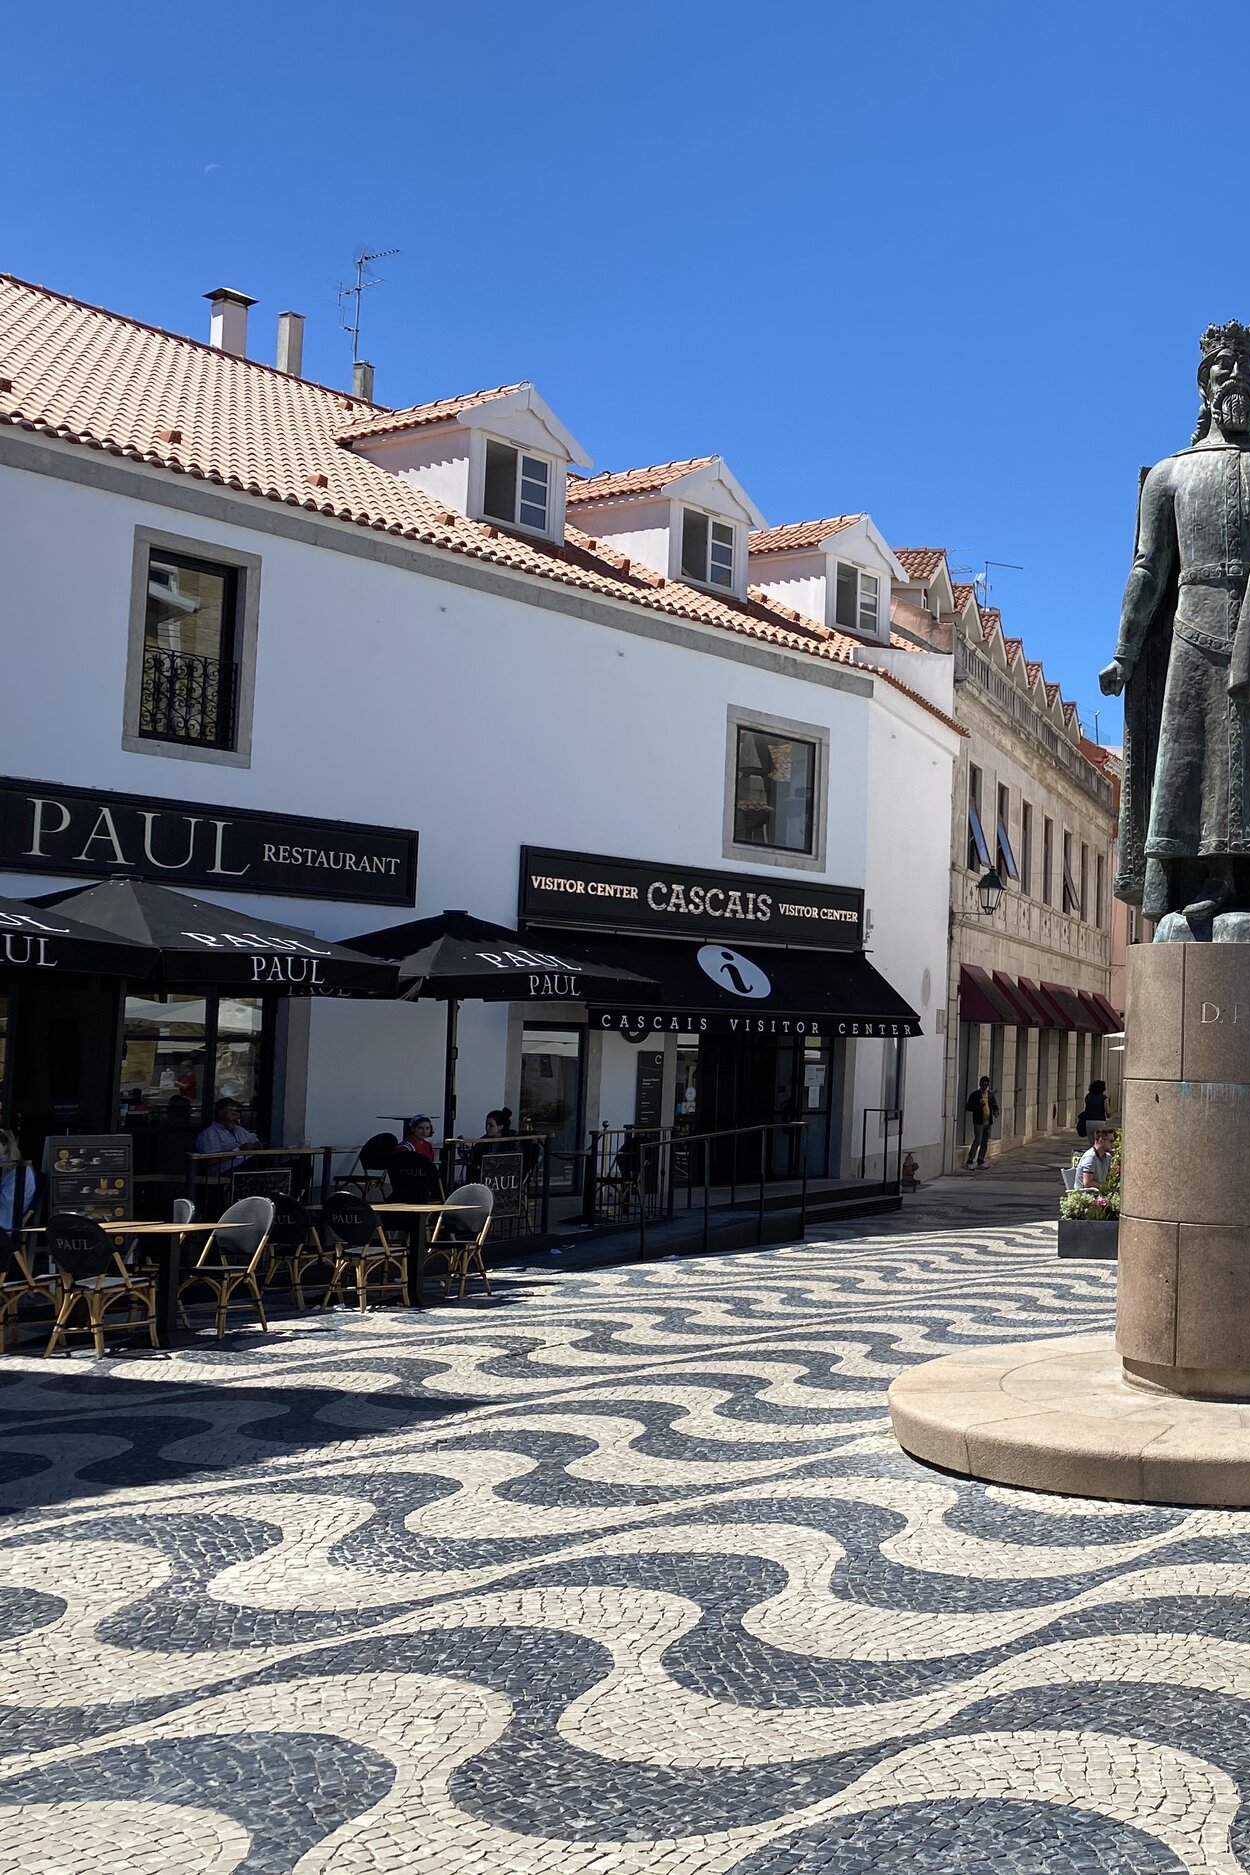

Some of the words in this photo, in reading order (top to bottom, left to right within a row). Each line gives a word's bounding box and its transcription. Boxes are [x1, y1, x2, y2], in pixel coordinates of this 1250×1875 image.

[21, 797, 251, 877] PAUL
[263, 843, 401, 876] RESTAURANT
[531, 875, 586, 895] VISITOR
[587, 882, 639, 900] CENTER
[647, 881, 772, 922] CASCAIS
[779, 903, 819, 918] VISITOR
[820, 908, 859, 923] CENTER
[0, 934, 58, 967] UL
[180, 931, 332, 956] PAUL
[251, 956, 326, 984] PAUL
[475, 949, 583, 972] PAUL
[529, 974, 582, 997] PAUL
[602, 1014, 708, 1031] CASCAIS
[730, 1018, 819, 1035] VISITOR
[838, 1022, 912, 1036] CENTER
[484, 1174, 520, 1191] PAUL
[332, 1213, 363, 1225] PAUL
[56, 1237, 95, 1252] PAUL
